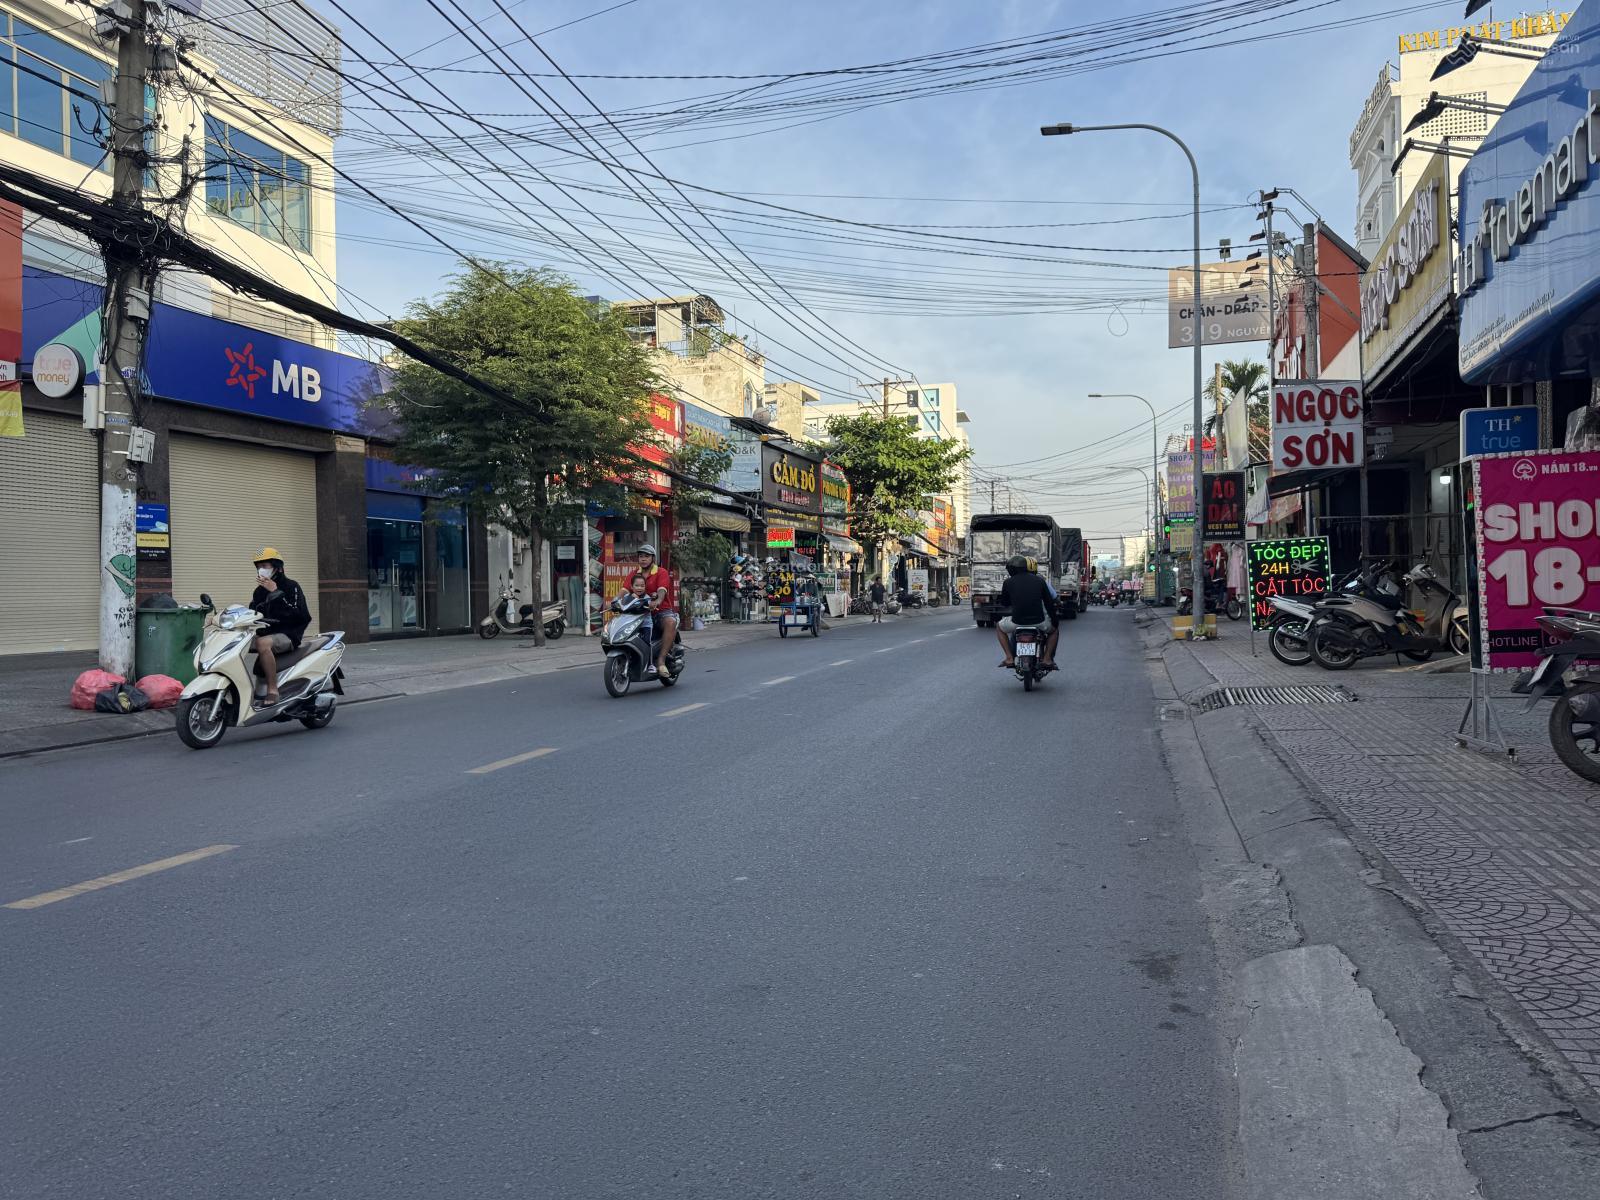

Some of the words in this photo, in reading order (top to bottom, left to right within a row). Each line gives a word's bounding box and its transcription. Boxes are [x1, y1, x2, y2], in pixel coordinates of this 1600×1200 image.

[1399, 31, 1441, 53] KIM
[1456, 234, 1485, 299] TH
[1489, 90, 1600, 262] truemart
[39, 355, 72, 371] true
[37, 373, 70, 385] money
[271, 359, 322, 402] MB
[1275, 384, 1360, 426] NGỌC
[1485, 418, 1512, 432] TH
[1282, 428, 1354, 467] SƠN
[1481, 434, 1521, 449] true
[1484, 500, 1600, 541] SHO
[1254, 545, 1285, 560] TÓC
[1290, 545, 1321, 560] ĐẸP
[1261, 562, 1289, 575] 24H
[1292, 574, 1325, 594] TÓC
